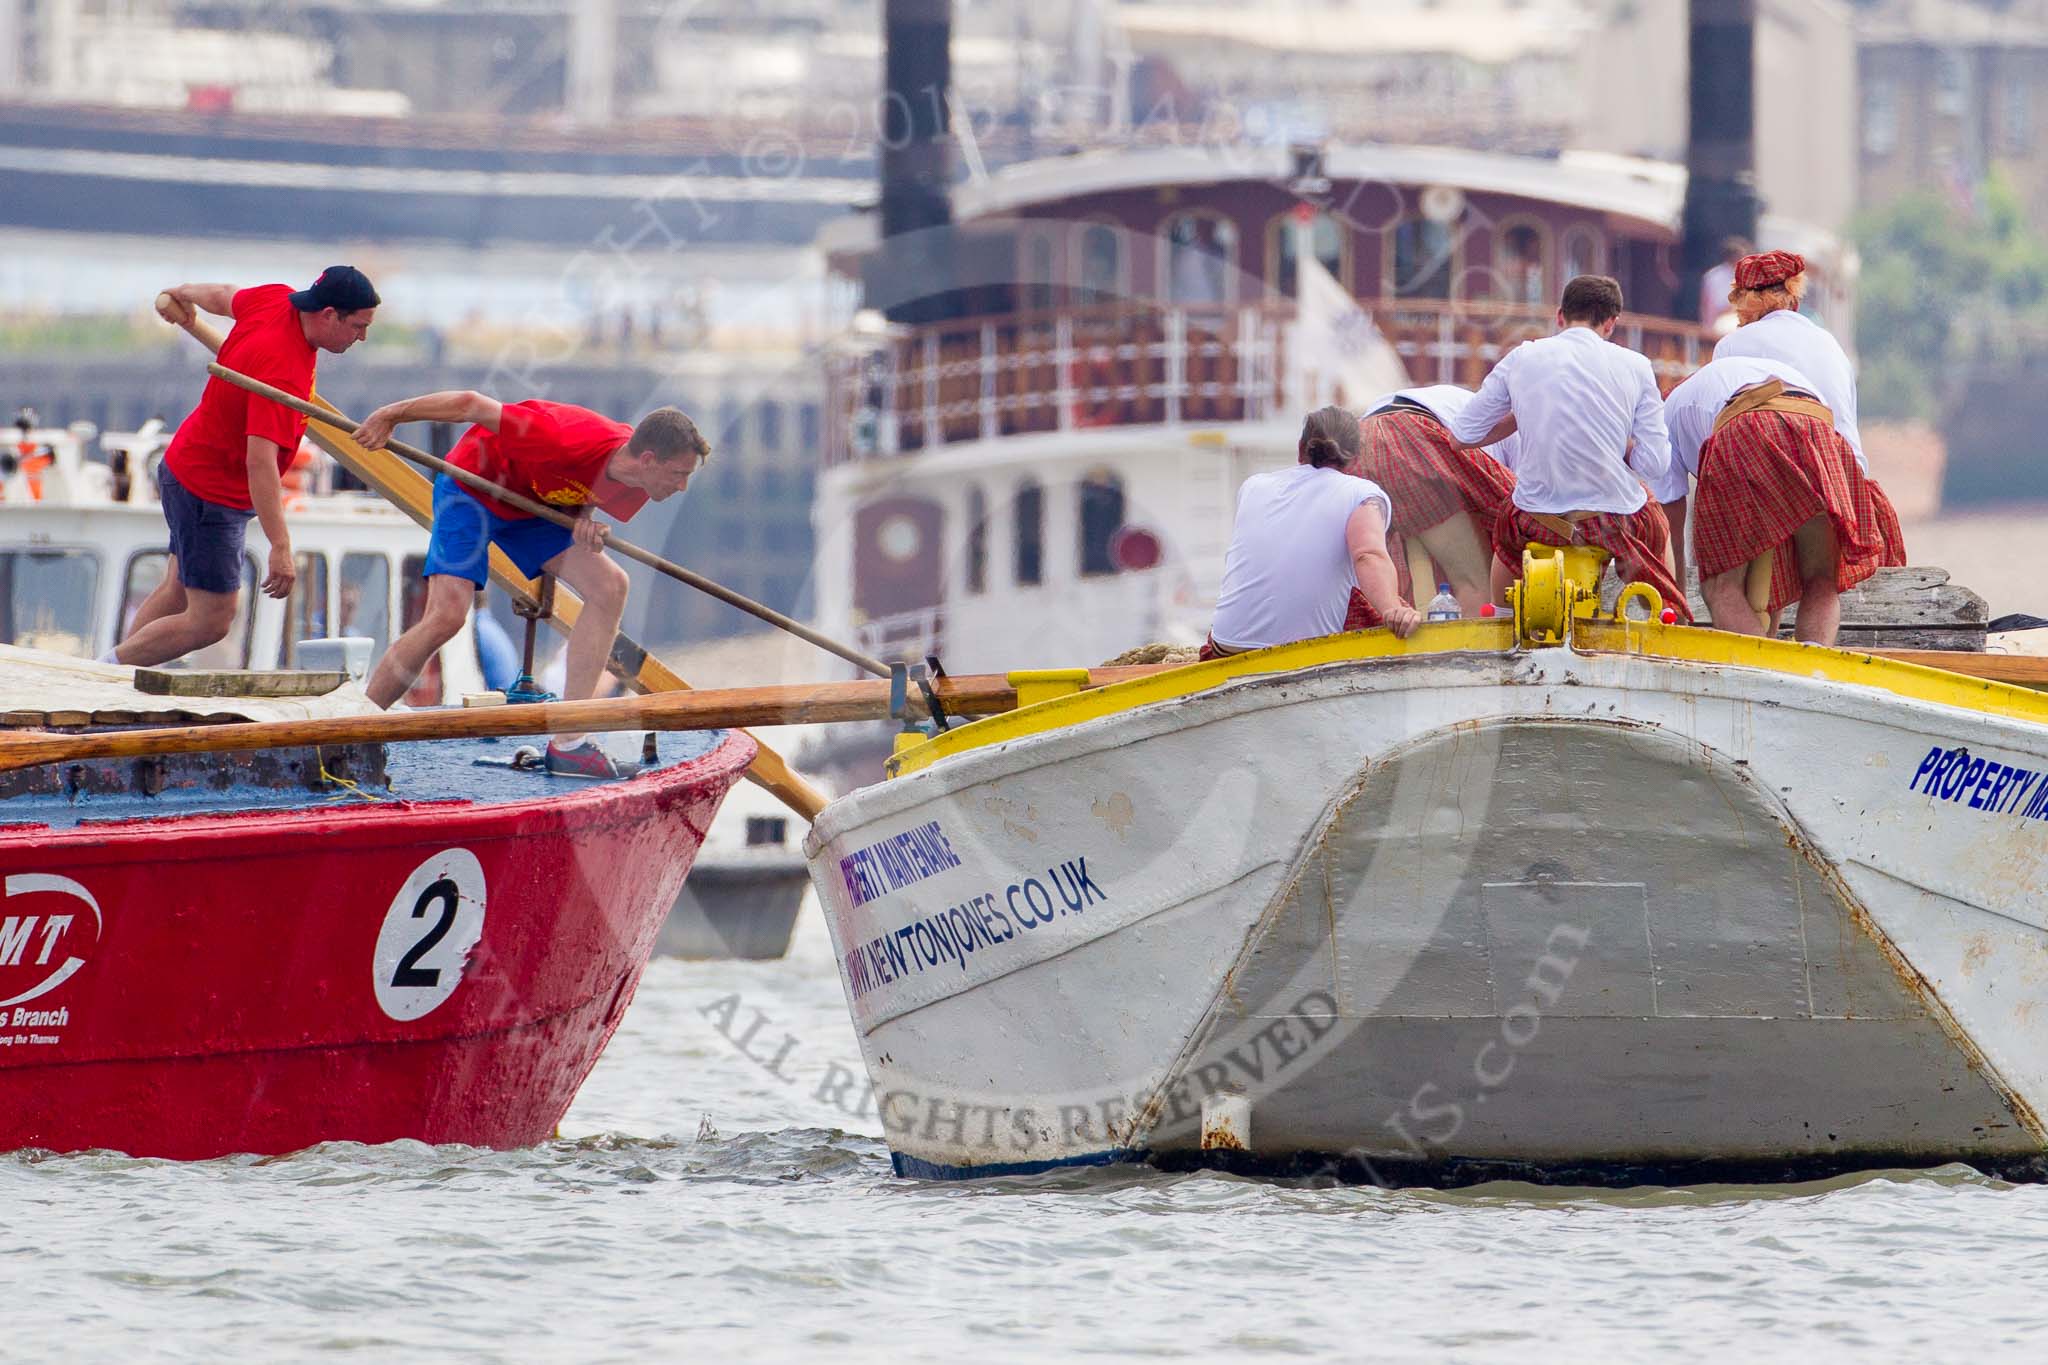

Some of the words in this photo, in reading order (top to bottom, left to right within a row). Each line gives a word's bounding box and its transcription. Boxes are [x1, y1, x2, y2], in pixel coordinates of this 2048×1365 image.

[1909, 746, 2041, 815] PROPERTY
[391, 878, 460, 987] 2
[11, 1006, 69, 1026] Branch
